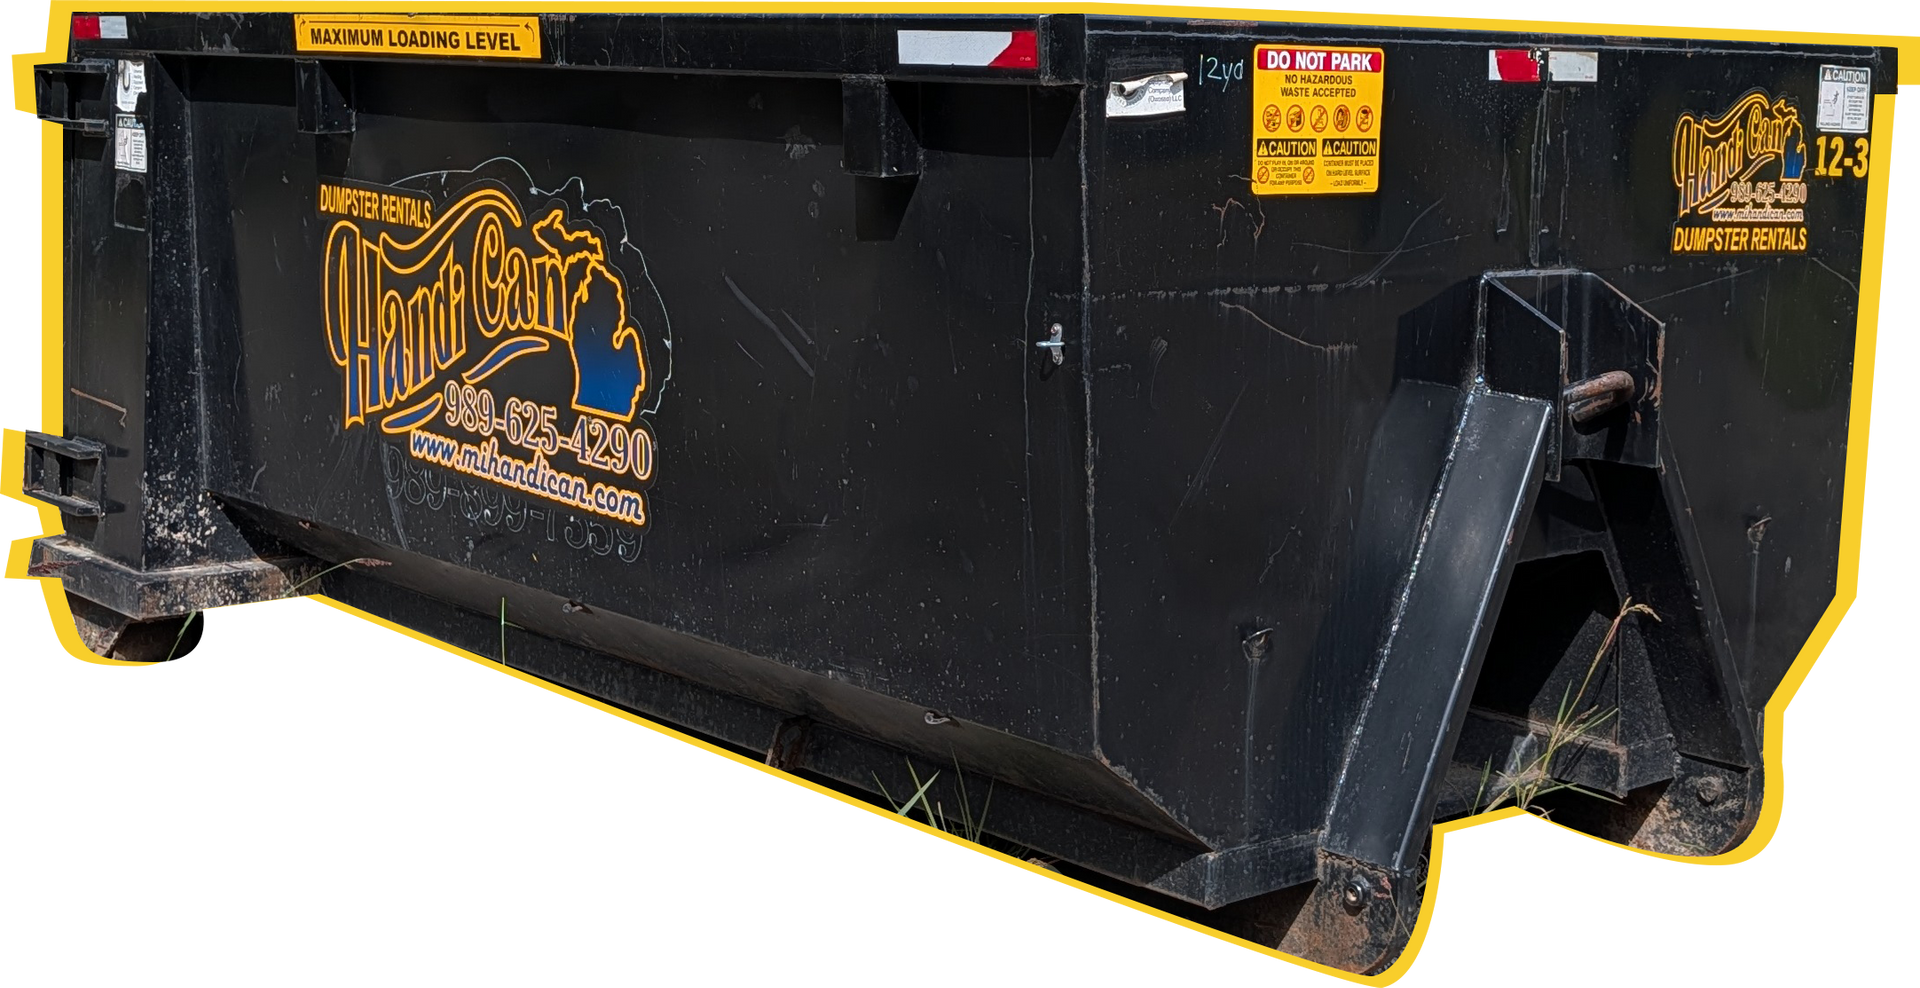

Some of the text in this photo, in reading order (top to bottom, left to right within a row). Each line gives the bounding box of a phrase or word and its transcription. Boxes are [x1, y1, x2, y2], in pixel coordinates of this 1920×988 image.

[310, 27, 521, 51] MAXIMUM LOADING LEVEL
[1267, 50, 1373, 71] DO NOT PARK
[1285, 74, 1353, 85] NO HAZARDOUS
[1832, 69, 1867, 83] CAUTION
[1280, 87, 1357, 98] WASTE ACCEPTED
[1269, 141, 1316, 156] CAUTION
[1333, 140, 1376, 155] CAUTION
[1814, 135, 1869, 178] 12-3
[1673, 104, 1784, 217] Handi Can
[1730, 181, 1807, 204] 989-625-4290
[320, 183, 432, 229] DUMPSTER RENTALS
[1712, 202, 1804, 222] www.mihandican.com
[1673, 227, 1807, 251] DUMPSTER RENTALS
[324, 212, 571, 429] Handi Can
[443, 379, 653, 481] 989-625-4290
[410, 429, 646, 526] www.mihandican.com
